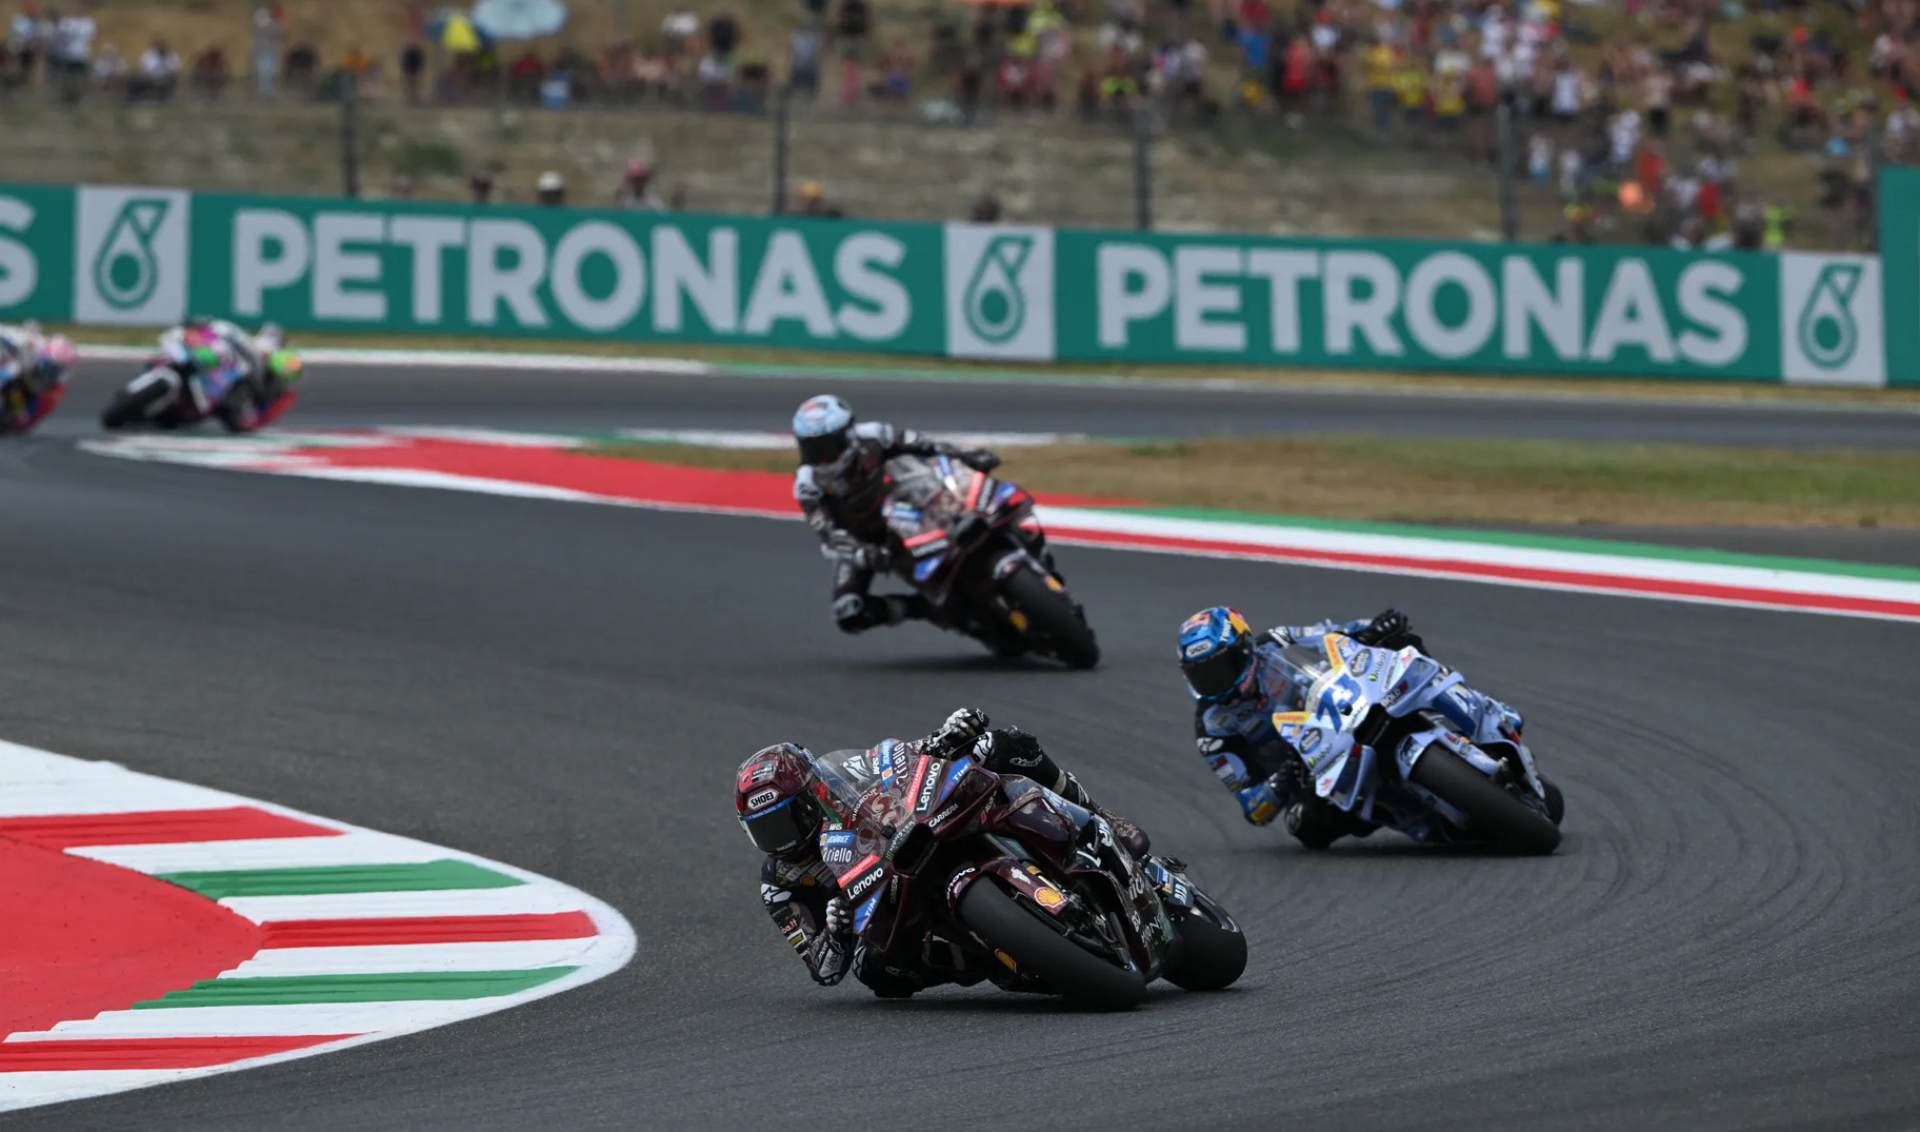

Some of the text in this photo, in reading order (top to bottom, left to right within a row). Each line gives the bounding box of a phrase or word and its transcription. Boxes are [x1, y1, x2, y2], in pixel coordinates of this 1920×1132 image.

[233, 208, 911, 341] PETRONAS
[1097, 242, 1748, 366] PETRONAS
[1316, 673, 1362, 735] 73
[916, 762, 941, 811] Lenovo
[953, 762, 970, 780] TIM
[751, 791, 774, 808] SHOEI
[847, 867, 884, 900] Lenovo
[864, 898, 877, 918] TIM
